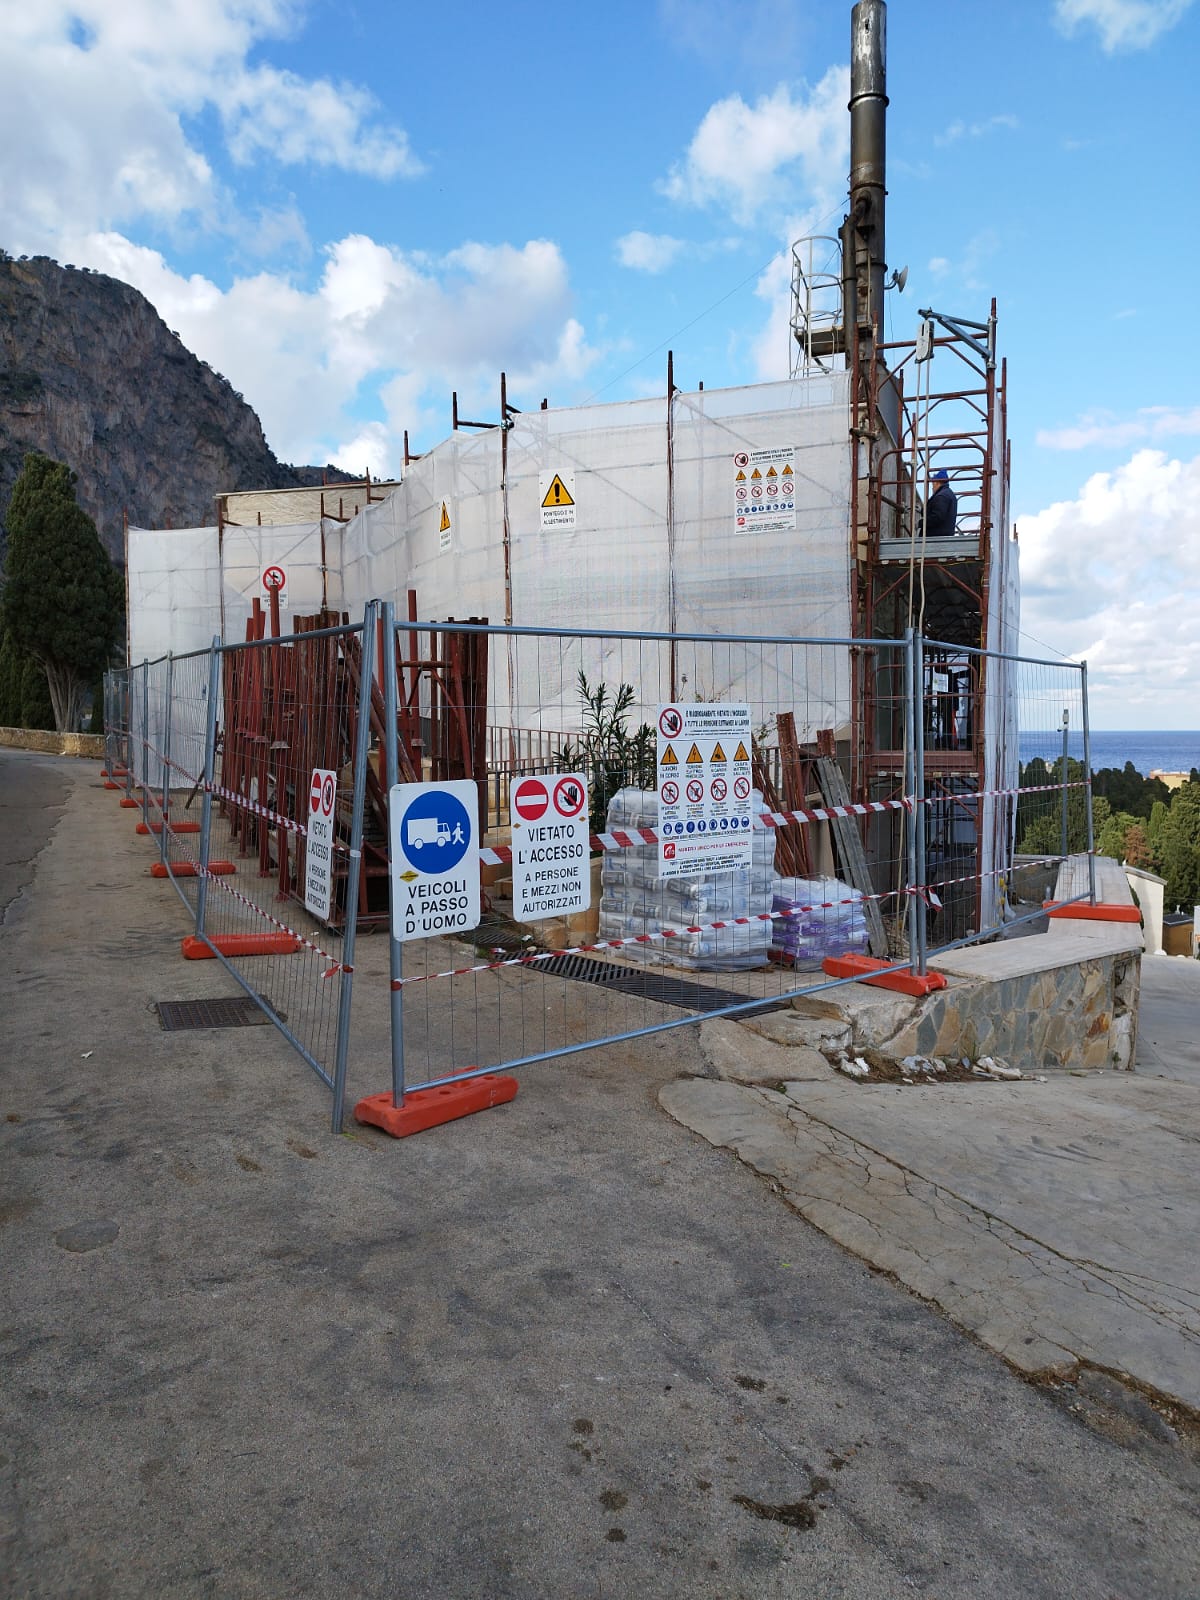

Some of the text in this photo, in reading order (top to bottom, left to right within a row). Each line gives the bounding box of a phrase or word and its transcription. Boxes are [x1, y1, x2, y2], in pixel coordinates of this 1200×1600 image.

[528, 824, 574, 842] VIETATO
[518, 844, 583, 864] L'ACCESSO
[525, 866, 578, 882] A PERSONE
[408, 880, 466, 898] VEICOLI
[522, 881, 581, 898] E MEZZI NON
[406, 896, 468, 916] A PASSO
[522, 896, 581, 913] AUTORIZZATI
[406, 913, 466, 934] D'UOMO
